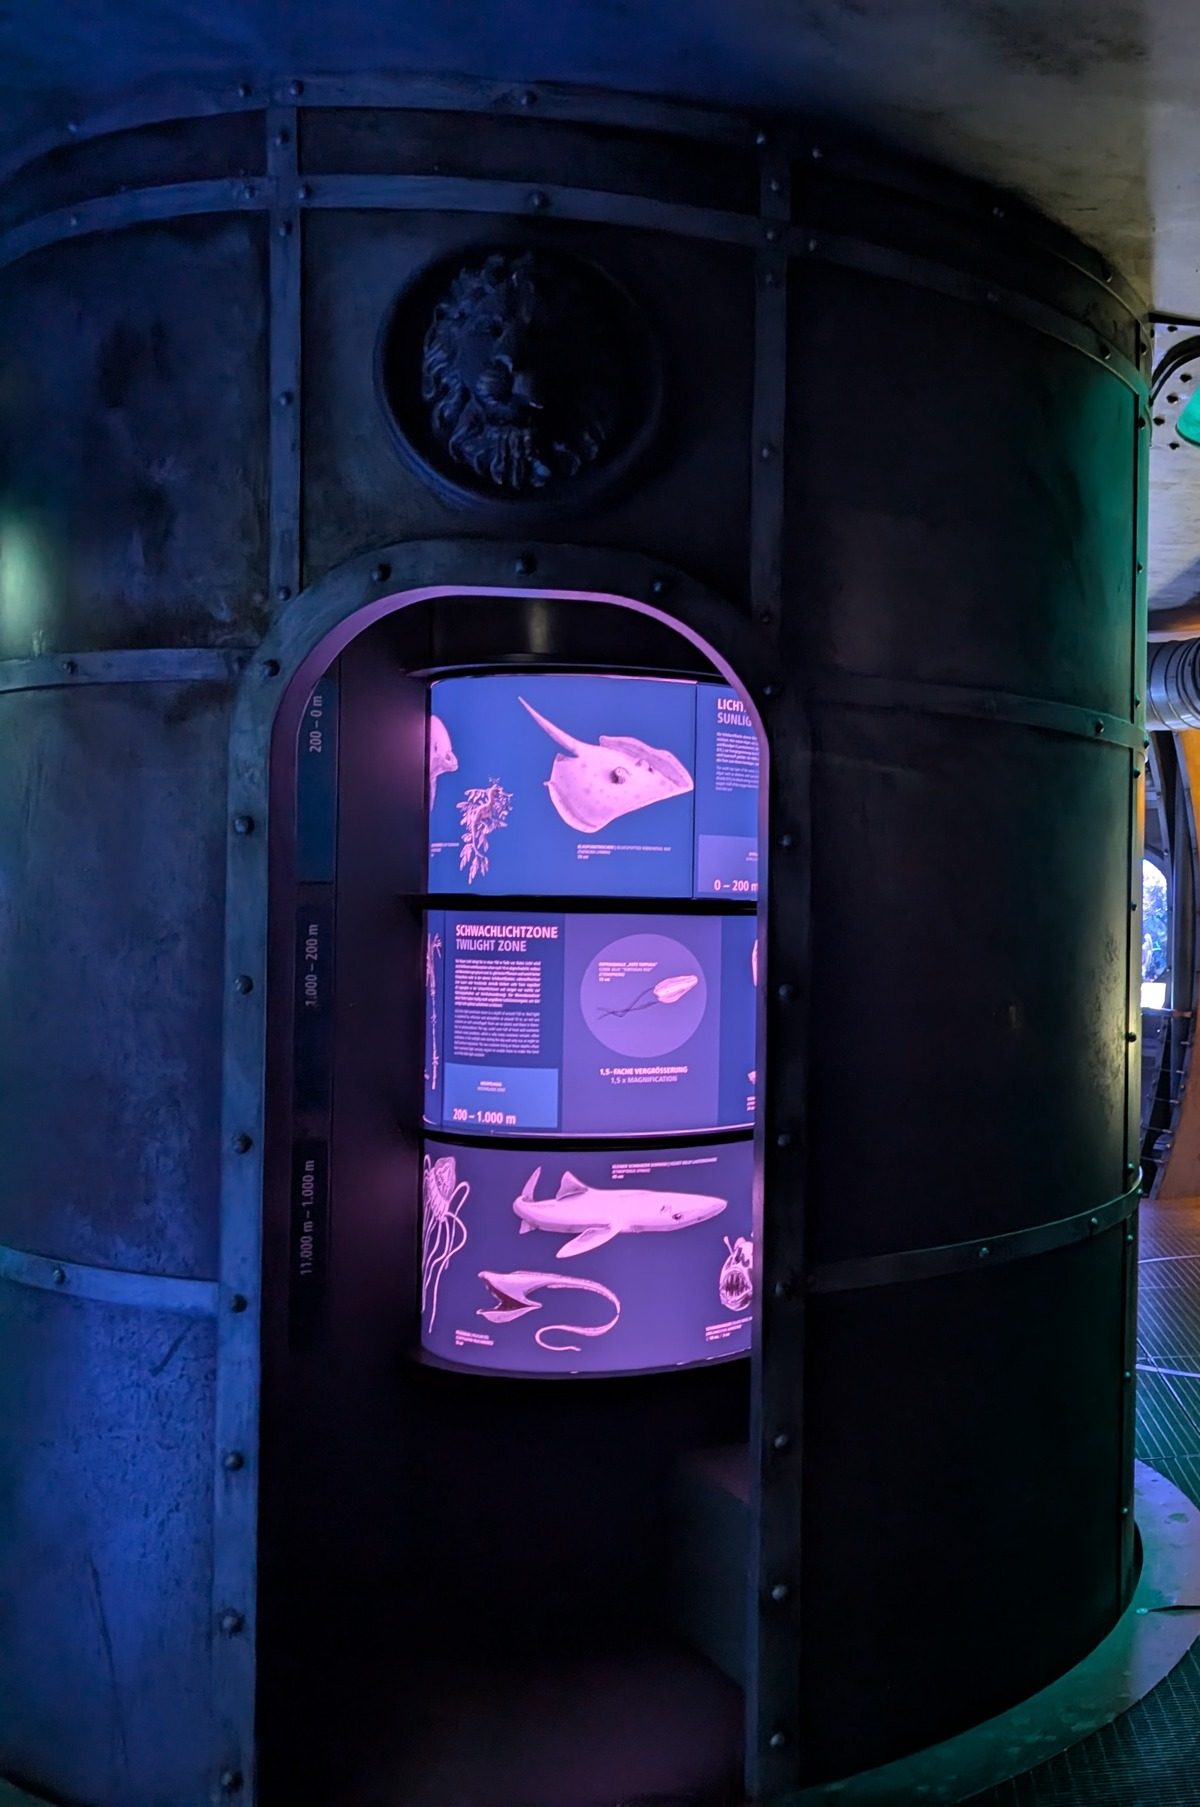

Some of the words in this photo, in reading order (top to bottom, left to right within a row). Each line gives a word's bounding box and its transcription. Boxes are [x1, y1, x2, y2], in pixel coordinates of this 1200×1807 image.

[313, 696, 322, 706] m
[717, 698, 747, 713] LICH
[310, 709, 322, 717] 0
[309, 731, 322, 752] 200
[714, 880, 721, 891] 0
[732, 880, 749, 892] 200
[308, 924, 318, 936] m
[455, 924, 559, 939] SCHWACHLICHTZONE
[305, 938, 318, 961] 200
[456, 938, 496, 951] TWILIGHT
[498, 940, 527, 952] ZONE
[627, 1075, 678, 1083] MAGNIFICATION
[453, 1108, 467, 1121] 200
[477, 1110, 503, 1124] 1.000
[506, 1115, 517, 1125] m
[305, 1160, 315, 1171] m
[302, 1174, 314, 1207] 1.000
[303, 1221, 313, 1232] m
